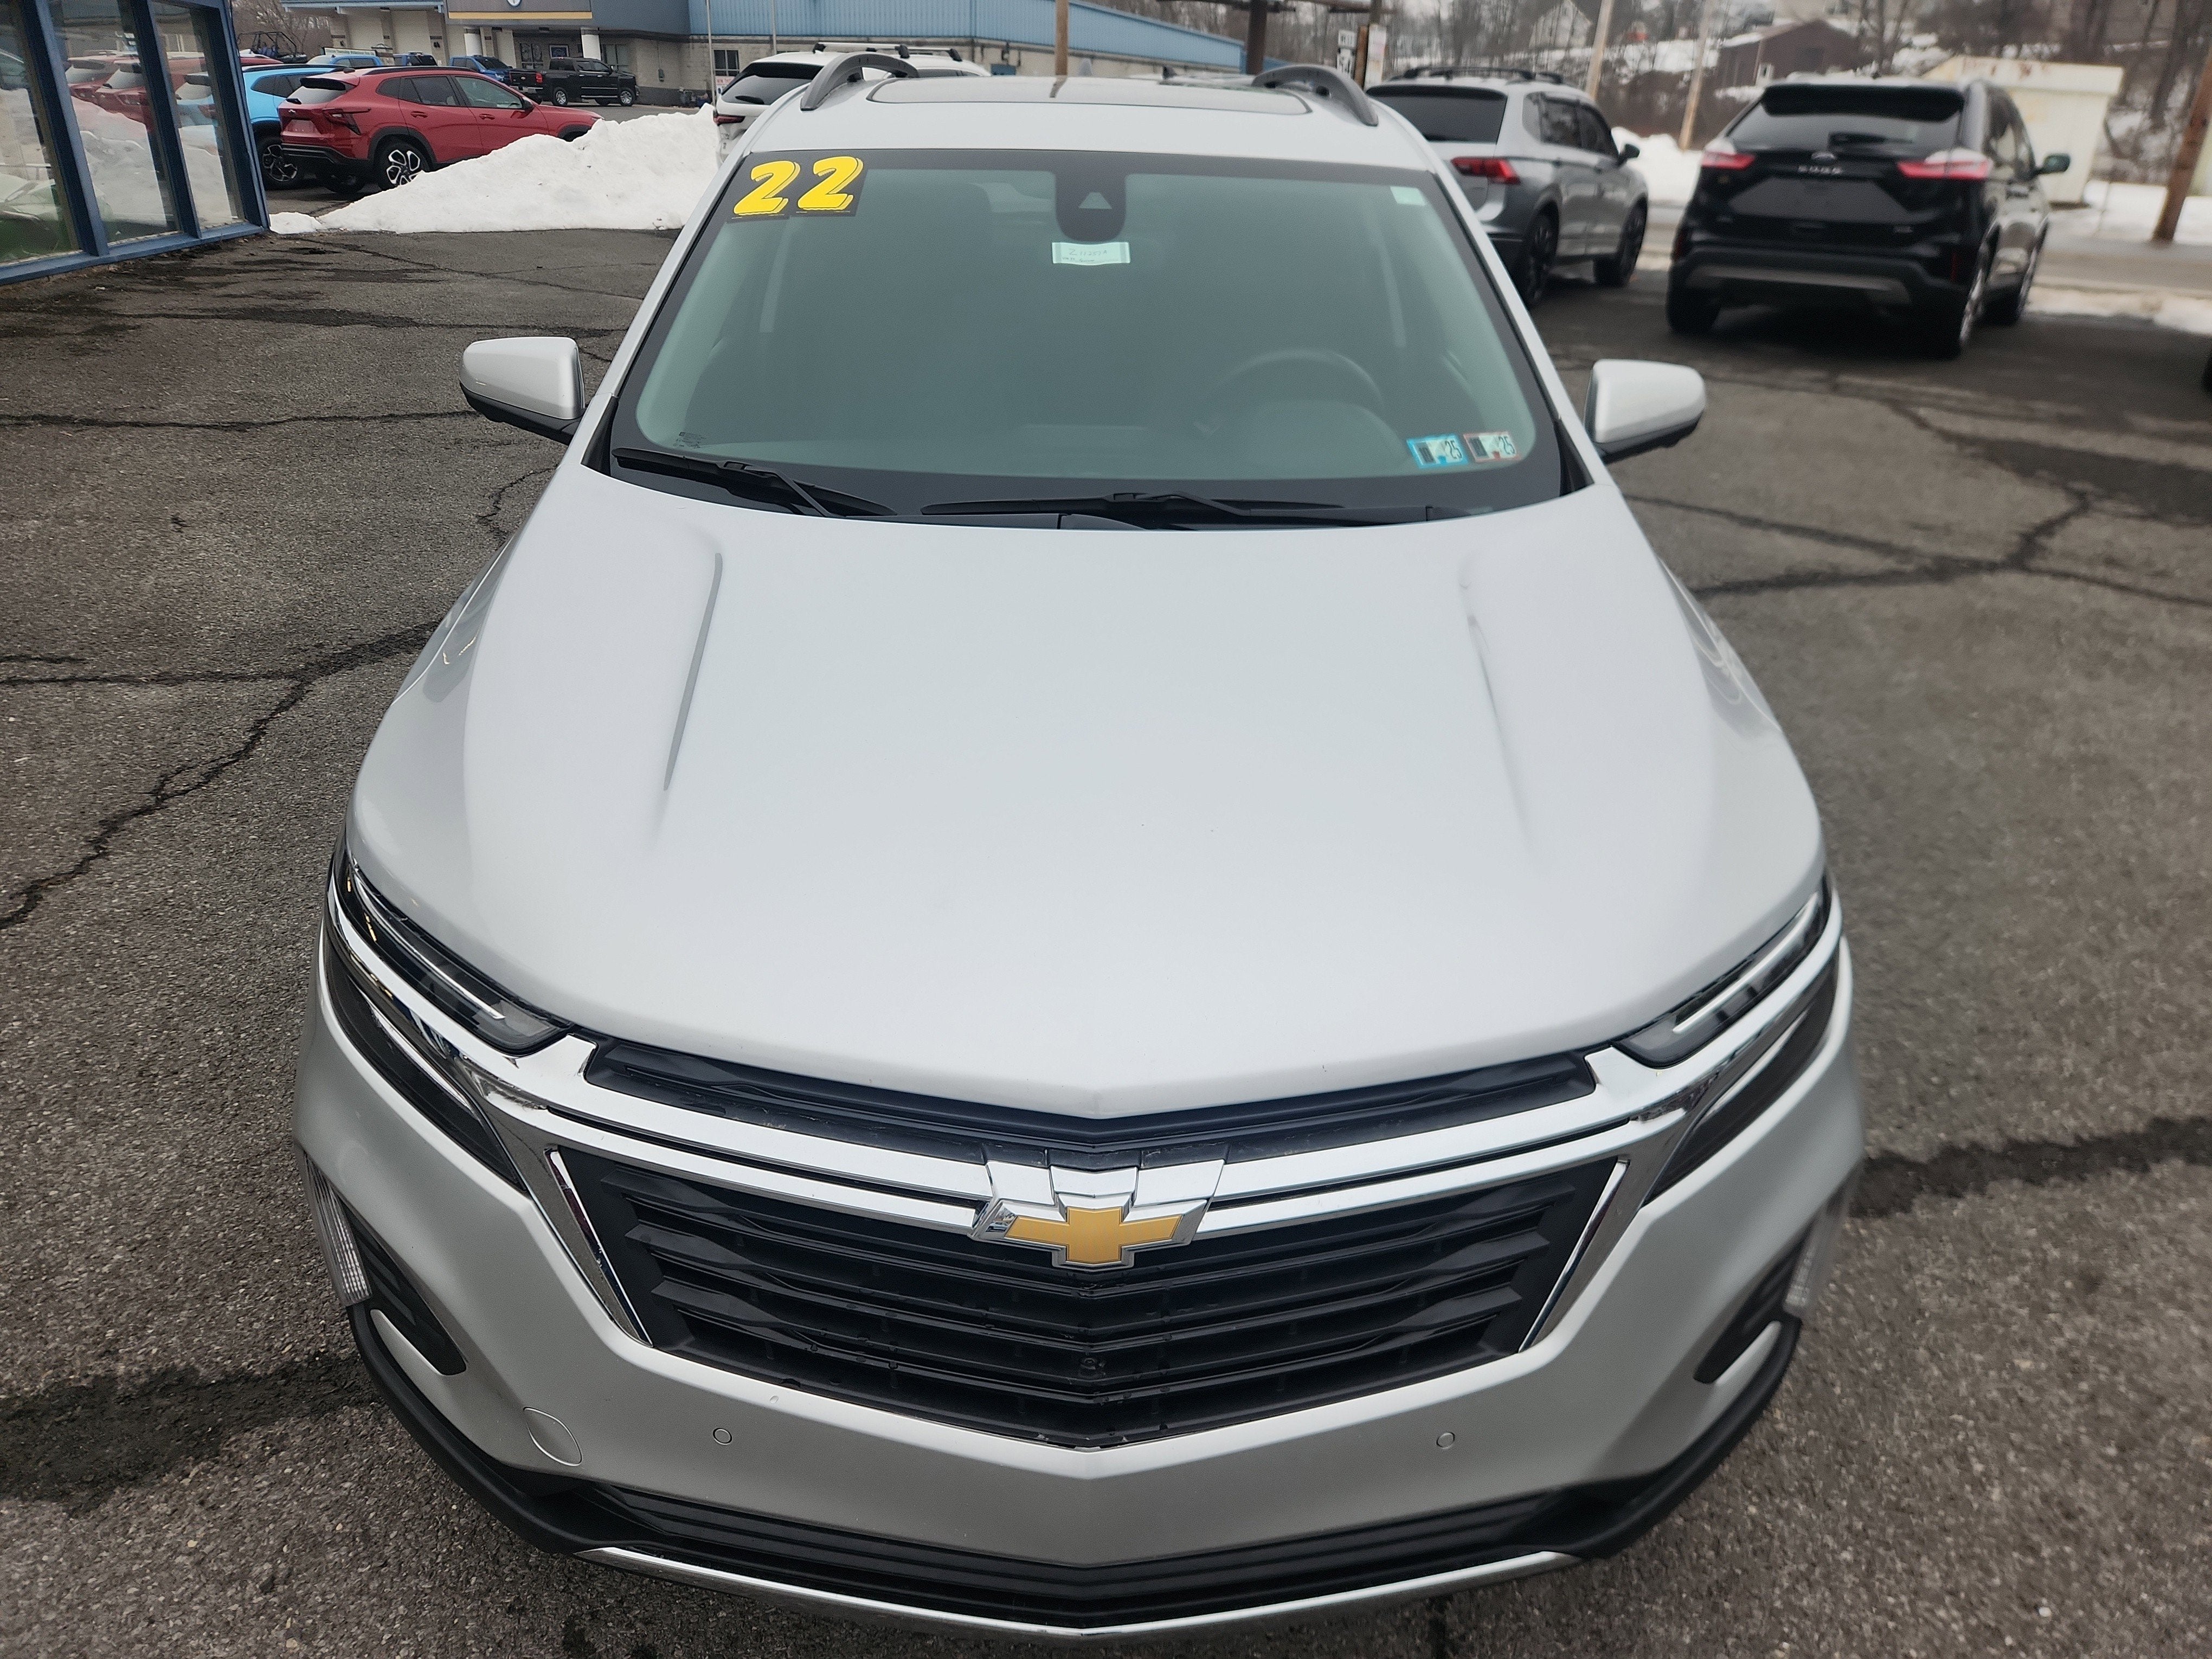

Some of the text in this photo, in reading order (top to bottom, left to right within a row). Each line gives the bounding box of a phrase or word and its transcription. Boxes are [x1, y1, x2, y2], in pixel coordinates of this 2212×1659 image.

[734, 156, 864, 216] 22
[1444, 438, 1463, 459] 25
[1498, 435, 1515, 455] 25
